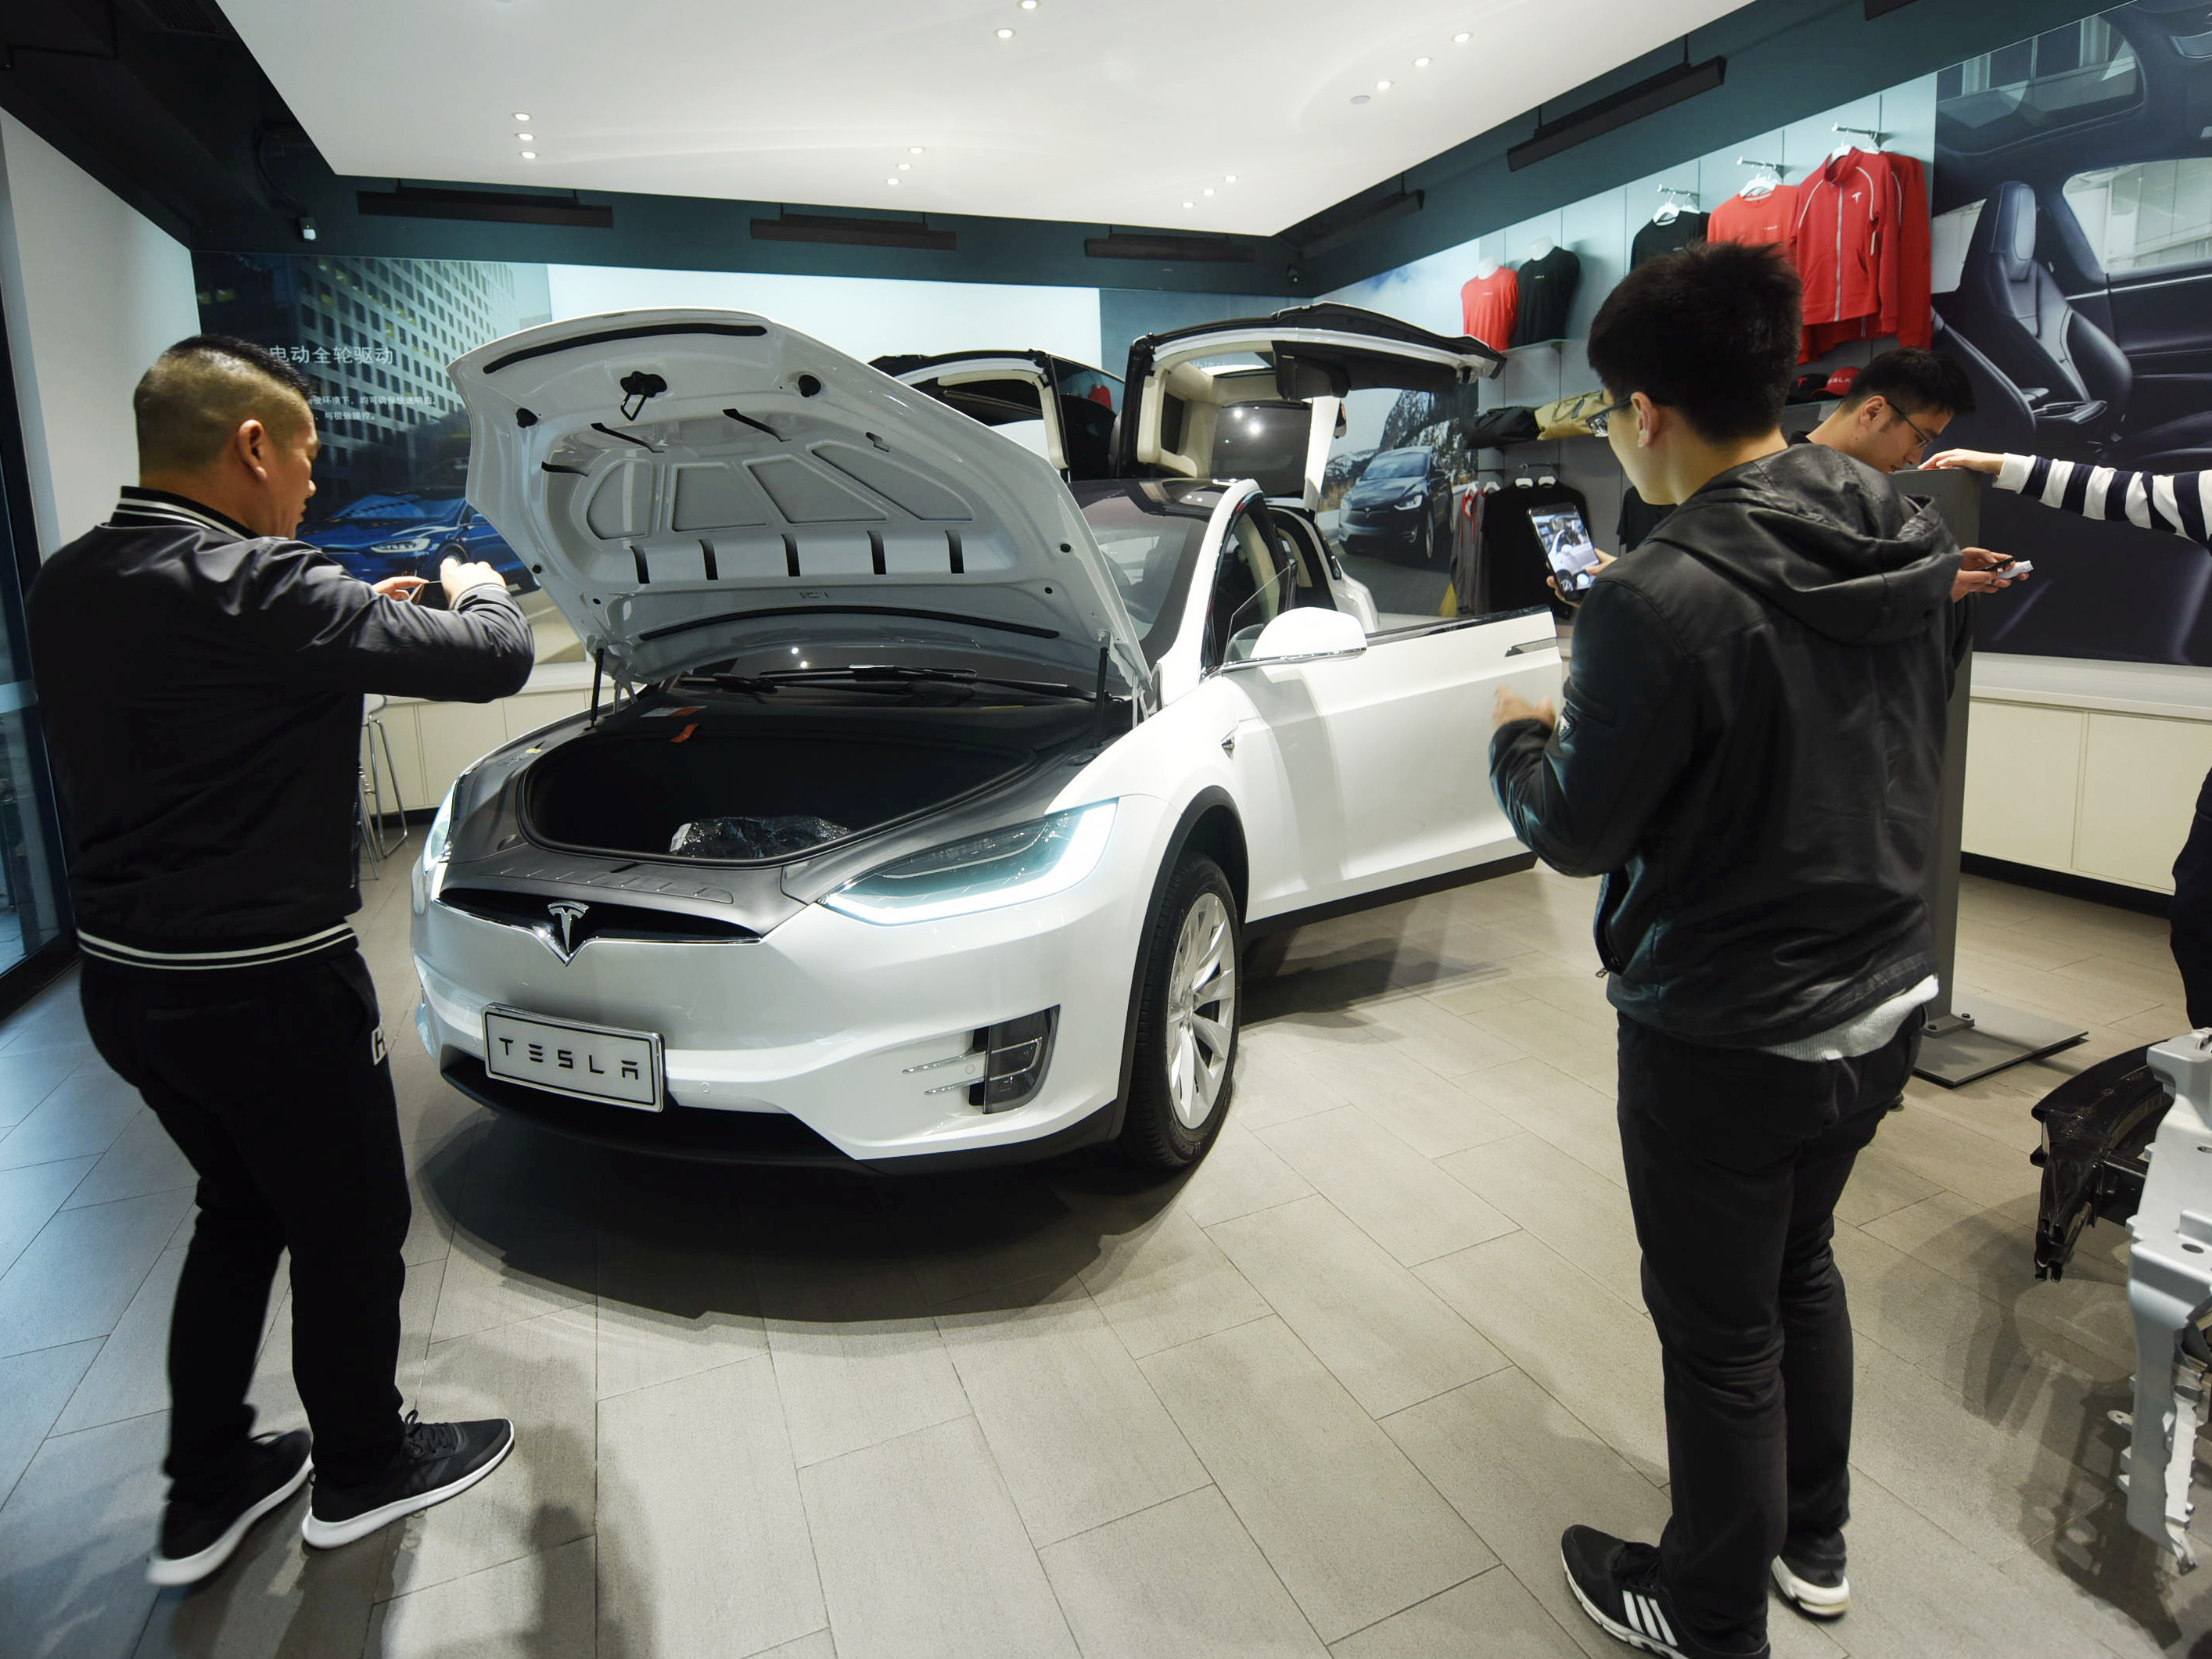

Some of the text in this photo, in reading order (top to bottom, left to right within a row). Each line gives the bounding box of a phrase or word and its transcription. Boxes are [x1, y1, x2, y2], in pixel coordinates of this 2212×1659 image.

[269, 345, 393, 364] 电动全轮驱动
[498, 1037, 639, 1080] TESLA
